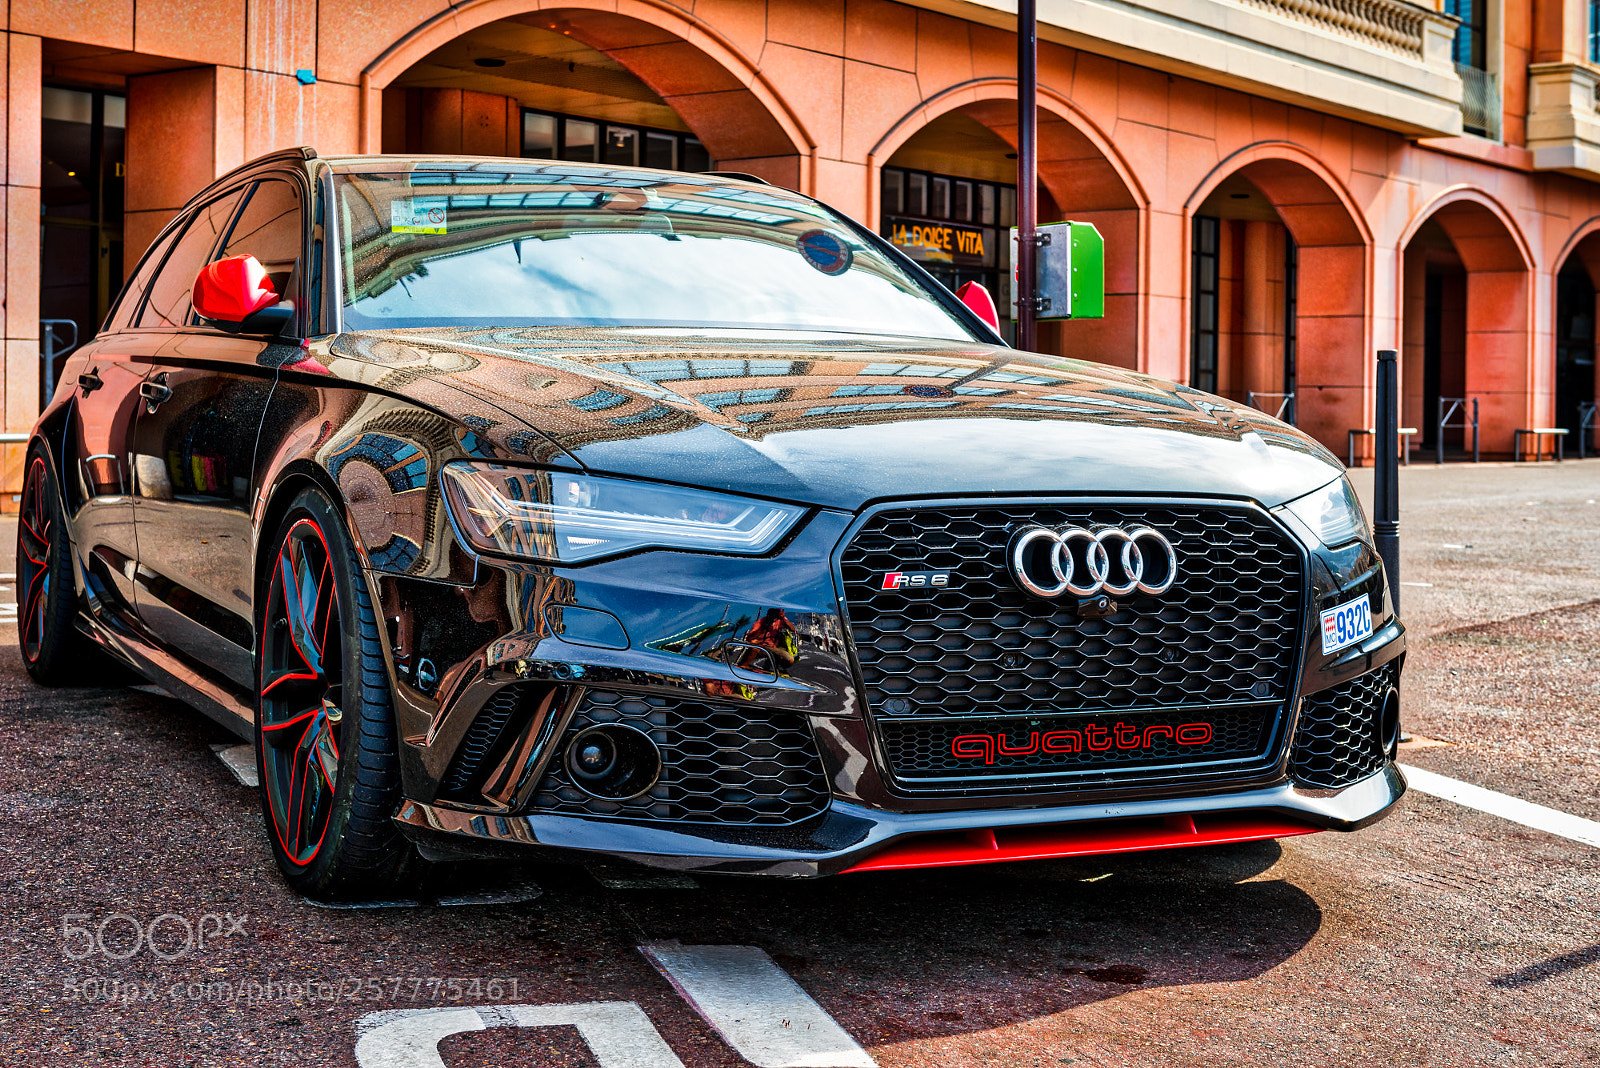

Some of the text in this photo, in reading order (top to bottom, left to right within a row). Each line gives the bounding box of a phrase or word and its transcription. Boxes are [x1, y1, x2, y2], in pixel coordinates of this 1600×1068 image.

[892, 223, 908, 245] LA
[912, 225, 953, 250] DOLCE
[892, 574, 949, 588] RS 6
[1337, 602, 1371, 643] 932C
[951, 723, 1213, 765] quattro
